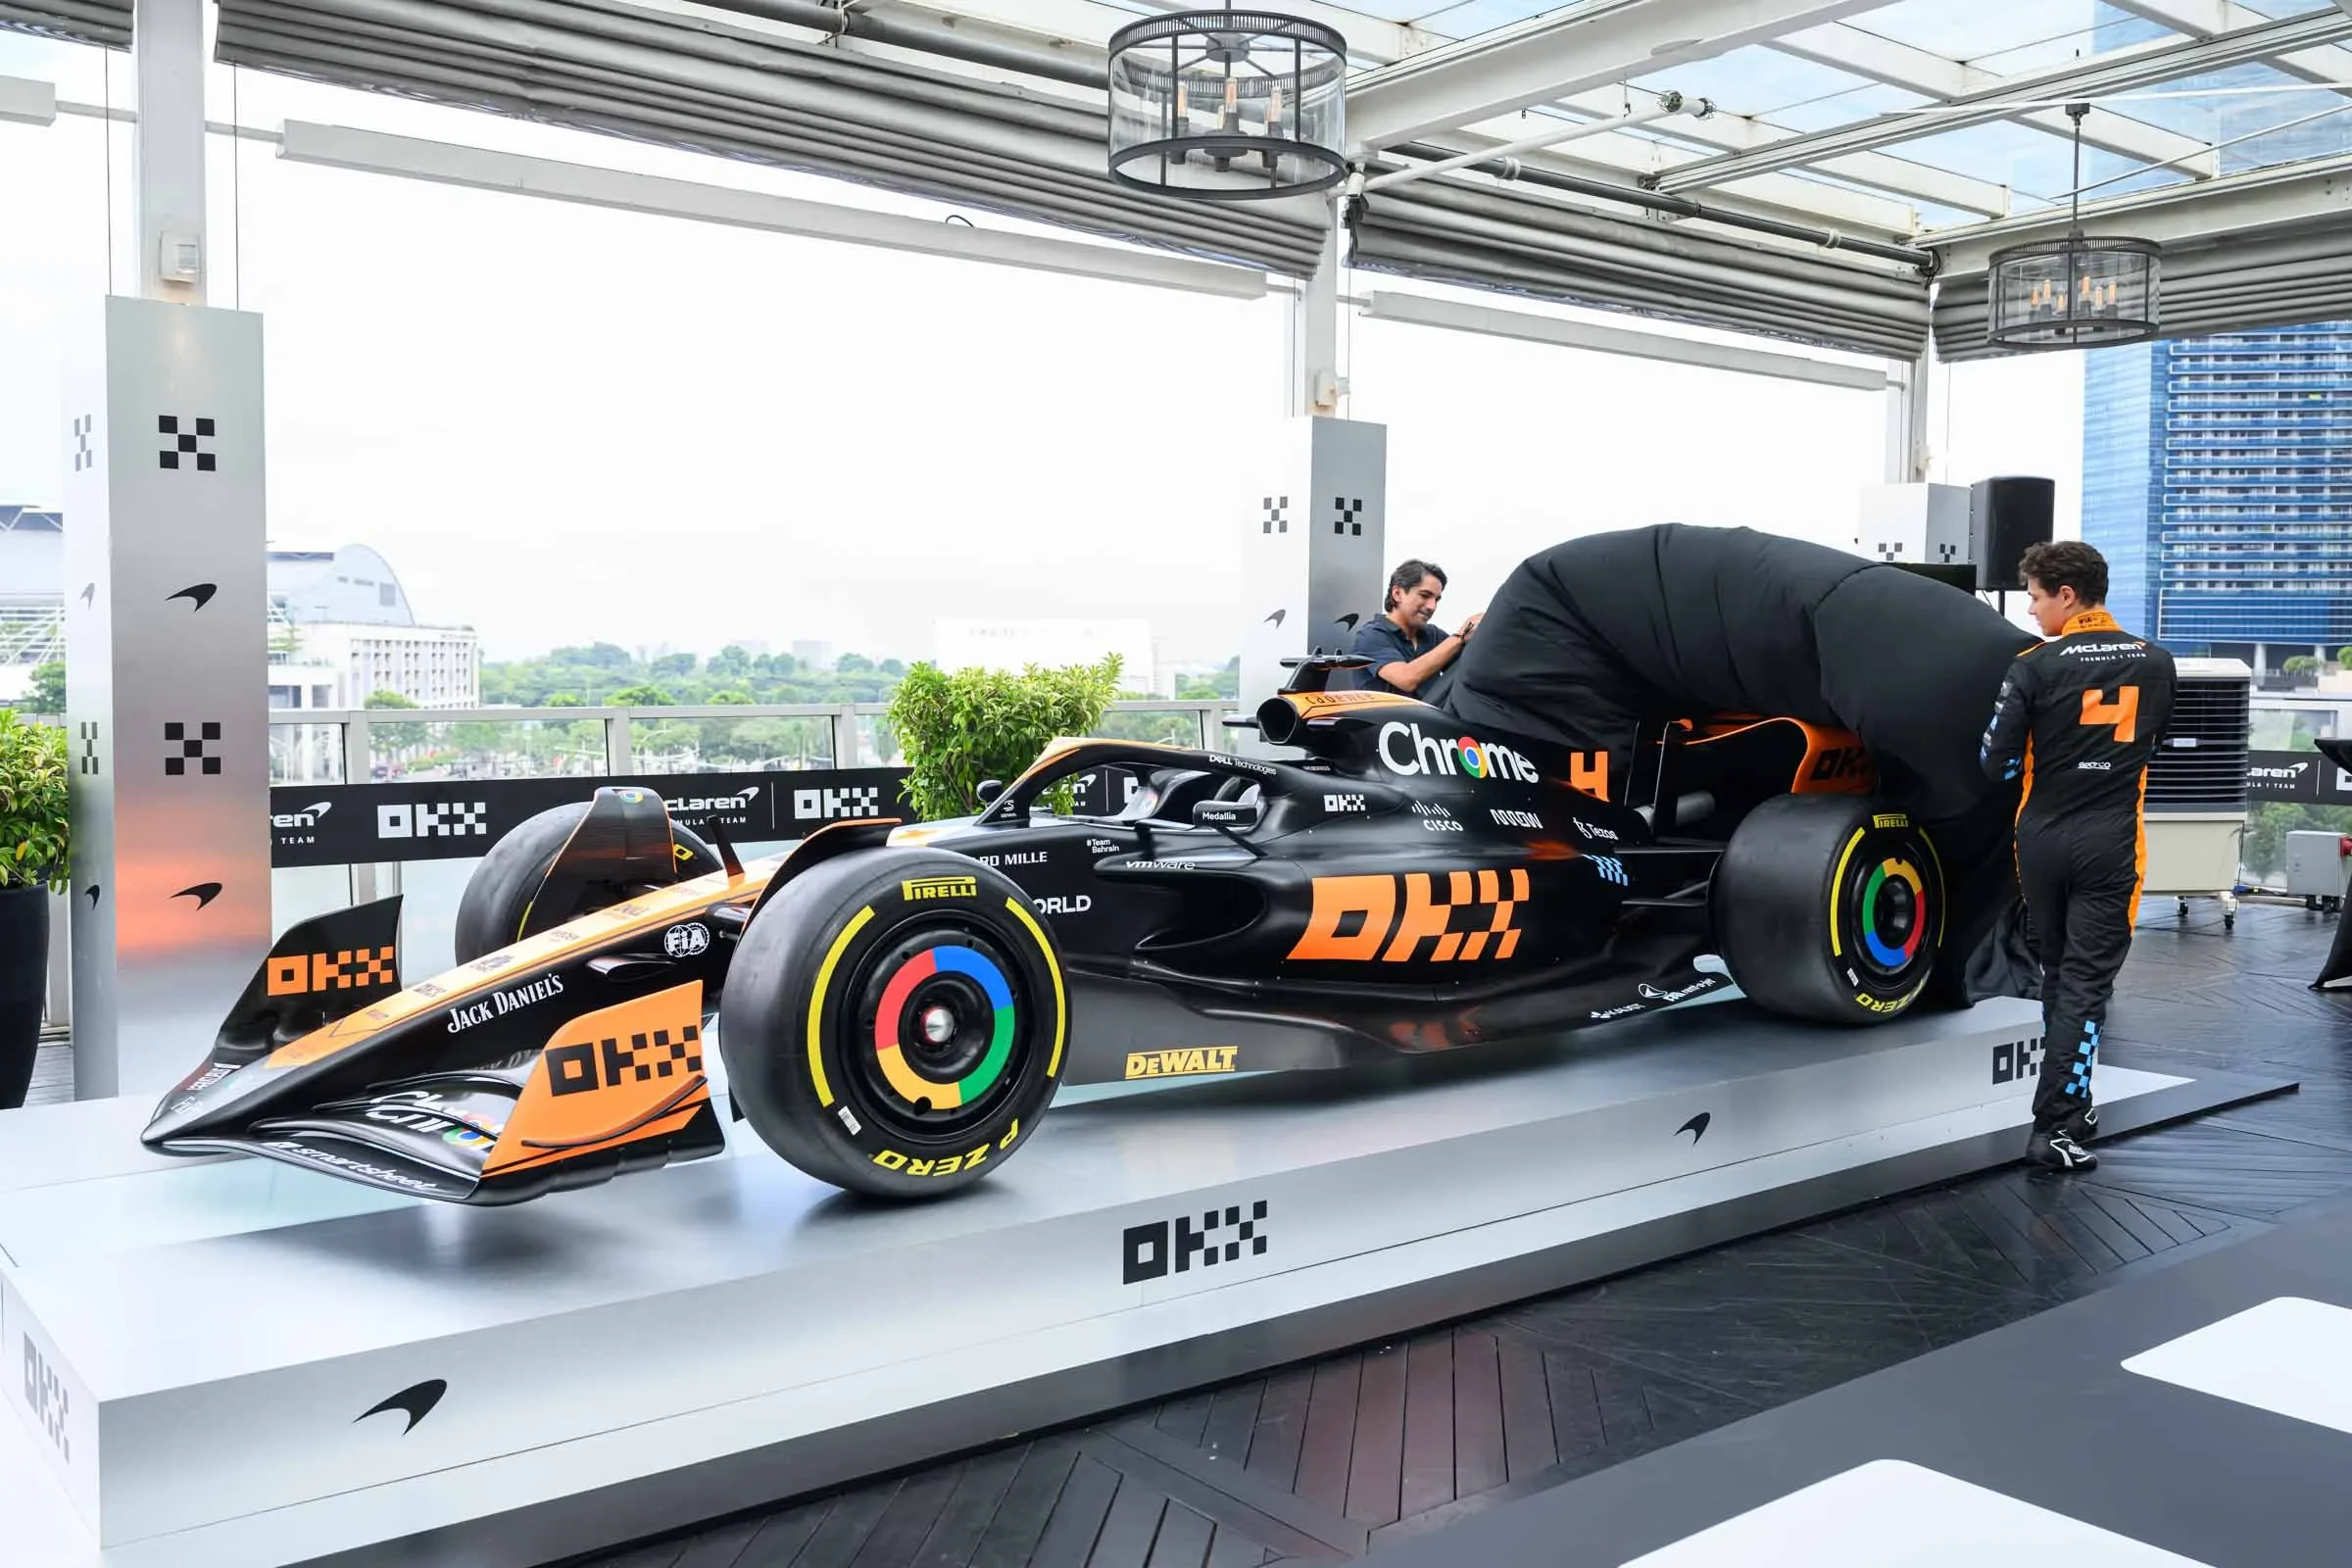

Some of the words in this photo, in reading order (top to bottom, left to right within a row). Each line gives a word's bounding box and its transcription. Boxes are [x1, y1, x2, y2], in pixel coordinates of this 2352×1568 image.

[2059, 643, 2142, 657] McLaren
[2079, 685, 2139, 743] 4
[1378, 721, 1539, 784] Chrome
[1810, 747, 1870, 781] OK
[1234, 760, 1277, 775] Technologies
[1570, 751, 1610, 803] 4
[665, 795, 747, 811] cLaren
[794, 787, 879, 819] OKX
[1202, 811, 1237, 821] Medallia
[1324, 794, 1366, 812] OKX
[377, 802, 487, 839] OKX
[720, 815, 747, 824] TEAM
[1588, 823, 1618, 840] Tezos
[281, 836, 316, 845] TEAM
[1092, 845, 1120, 854] Bahrain
[1004, 852, 1048, 865] MILLE
[1126, 860, 1196, 870] vmware
[902, 876, 977, 902] PIRELLI
[1034, 895, 1092, 914] ORLD
[1286, 868, 1530, 962] OKX
[267, 946, 394, 997] OKX
[1855, 993, 1911, 1013] ZERO
[448, 1002, 494, 1034] JACK
[545, 1025, 703, 1098] OKX
[999, 1117, 1018, 1150] P
[872, 1143, 991, 1177] ZERO
[1122, 1199, 1268, 1286] OKX
[23, 1330, 71, 1465] OKX
